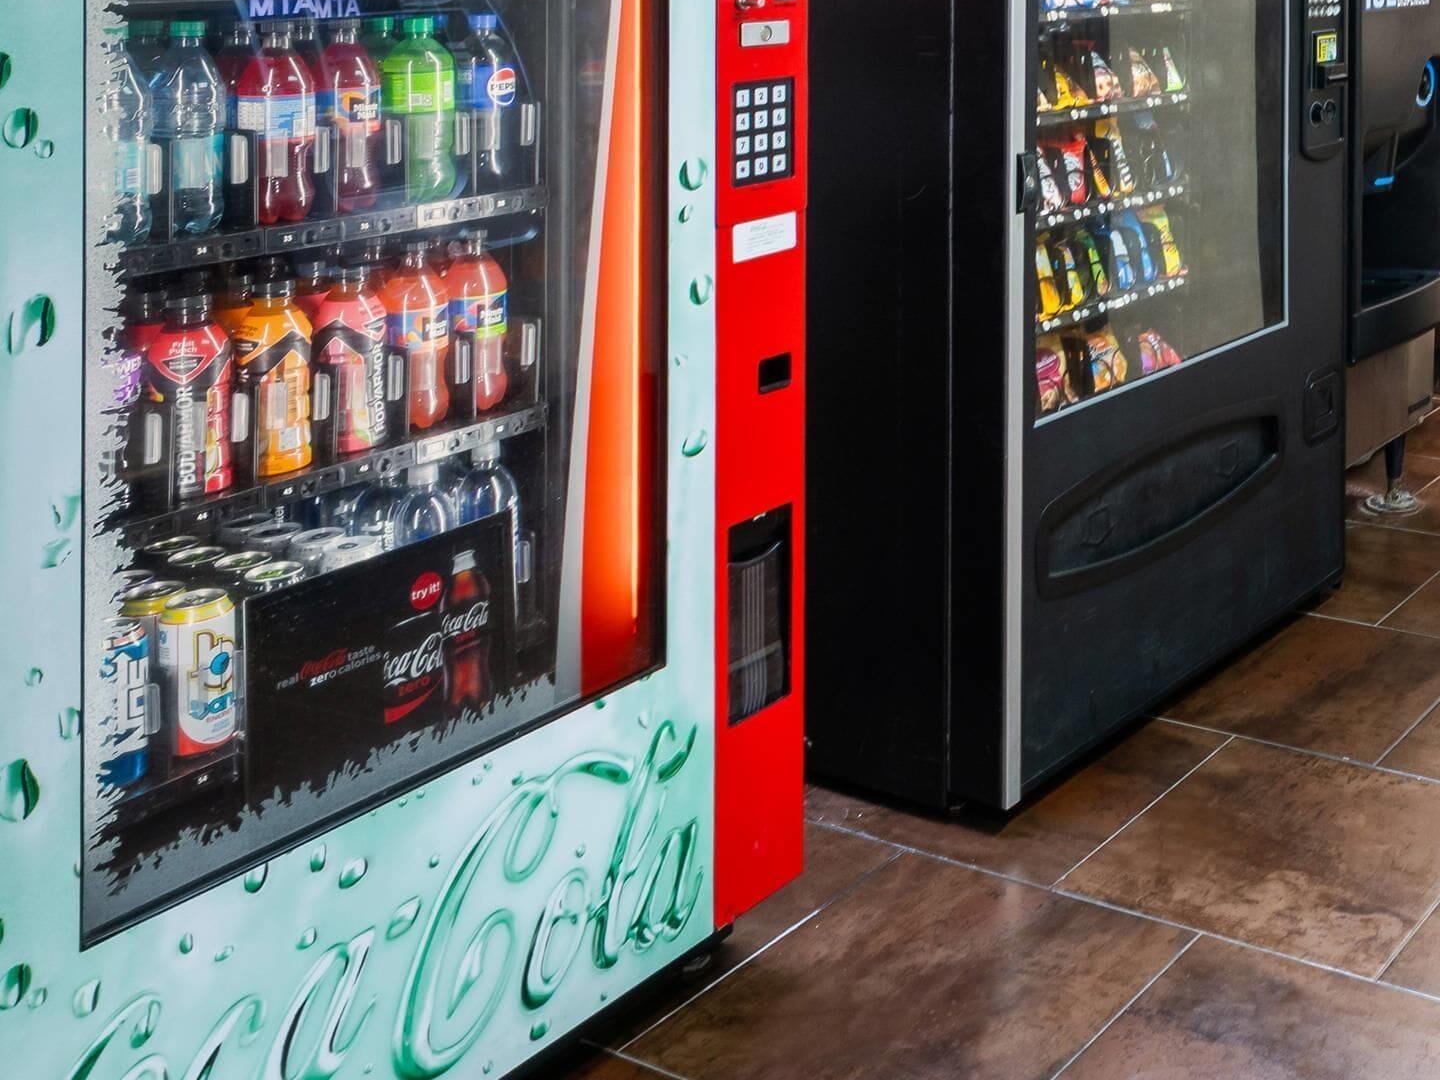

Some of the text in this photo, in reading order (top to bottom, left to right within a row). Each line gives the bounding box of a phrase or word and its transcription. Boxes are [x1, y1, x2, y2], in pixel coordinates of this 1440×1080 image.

[758, 91, 764, 101] 2
[776, 89, 783, 99] 3
[740, 112, 783, 127] 4 5 6
[740, 140, 746, 151] 7
[776, 135, 783, 145] 9
[758, 160, 764, 171] 0
[168, 346, 198, 356] Punch
[172, 340, 195, 349] Fruit
[176, 385, 196, 485] BODYARMOR
[283, 486, 294, 495] 45
[411, 581, 441, 601] try it!
[276, 672, 299, 690] real
[347, 643, 376, 660] taste
[309, 652, 382, 687] zero calories
[398, 676, 431, 697] zero
